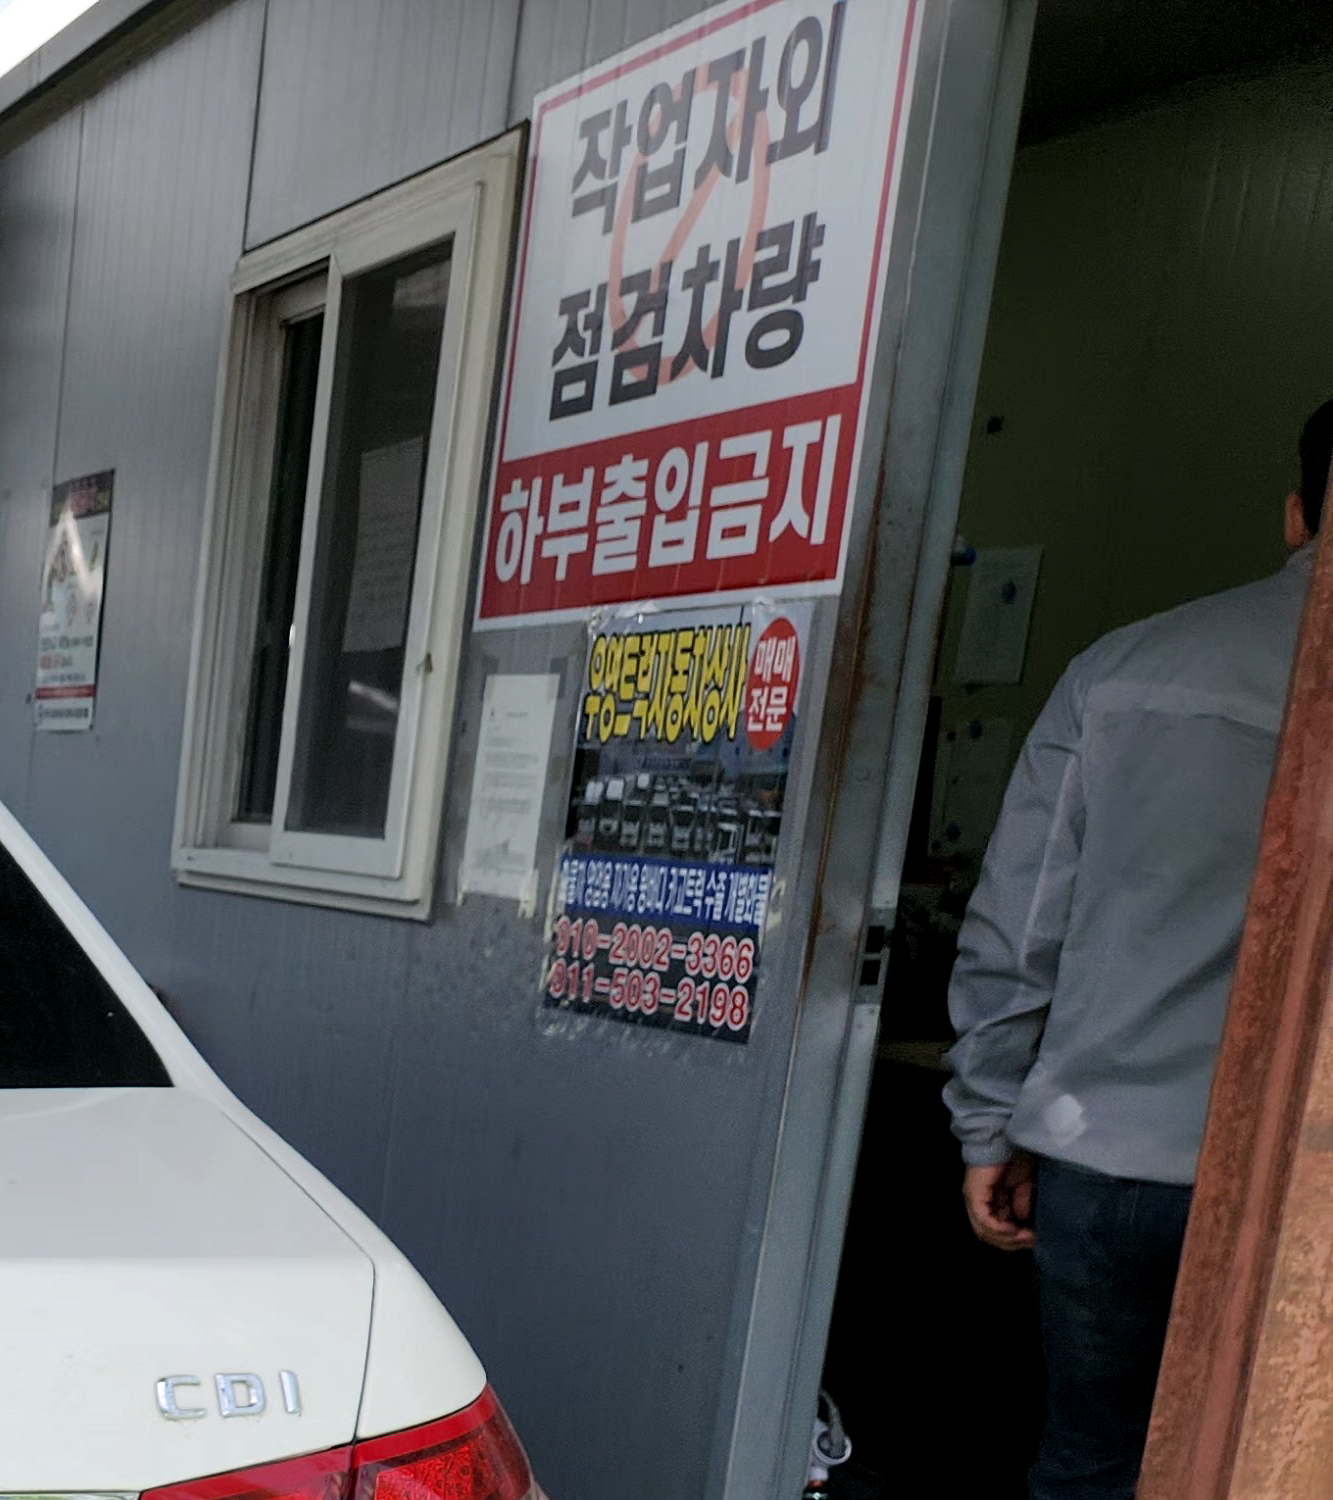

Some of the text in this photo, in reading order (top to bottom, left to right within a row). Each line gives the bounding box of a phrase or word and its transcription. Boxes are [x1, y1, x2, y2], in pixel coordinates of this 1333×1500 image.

[571, 4, 845, 236] 작업자외
[549, 211, 826, 422] 점검차량
[495, 413, 842, 585] 하부출입금지
[753, 636, 796, 684] 매매
[746, 686, 788, 733] 전문
[705, 870, 727, 921] 수출
[555, 914, 754, 983] 010-2002-3366
[549, 957, 748, 1031] 011-503-2198
[155, 1370, 301, 1421] CDI
